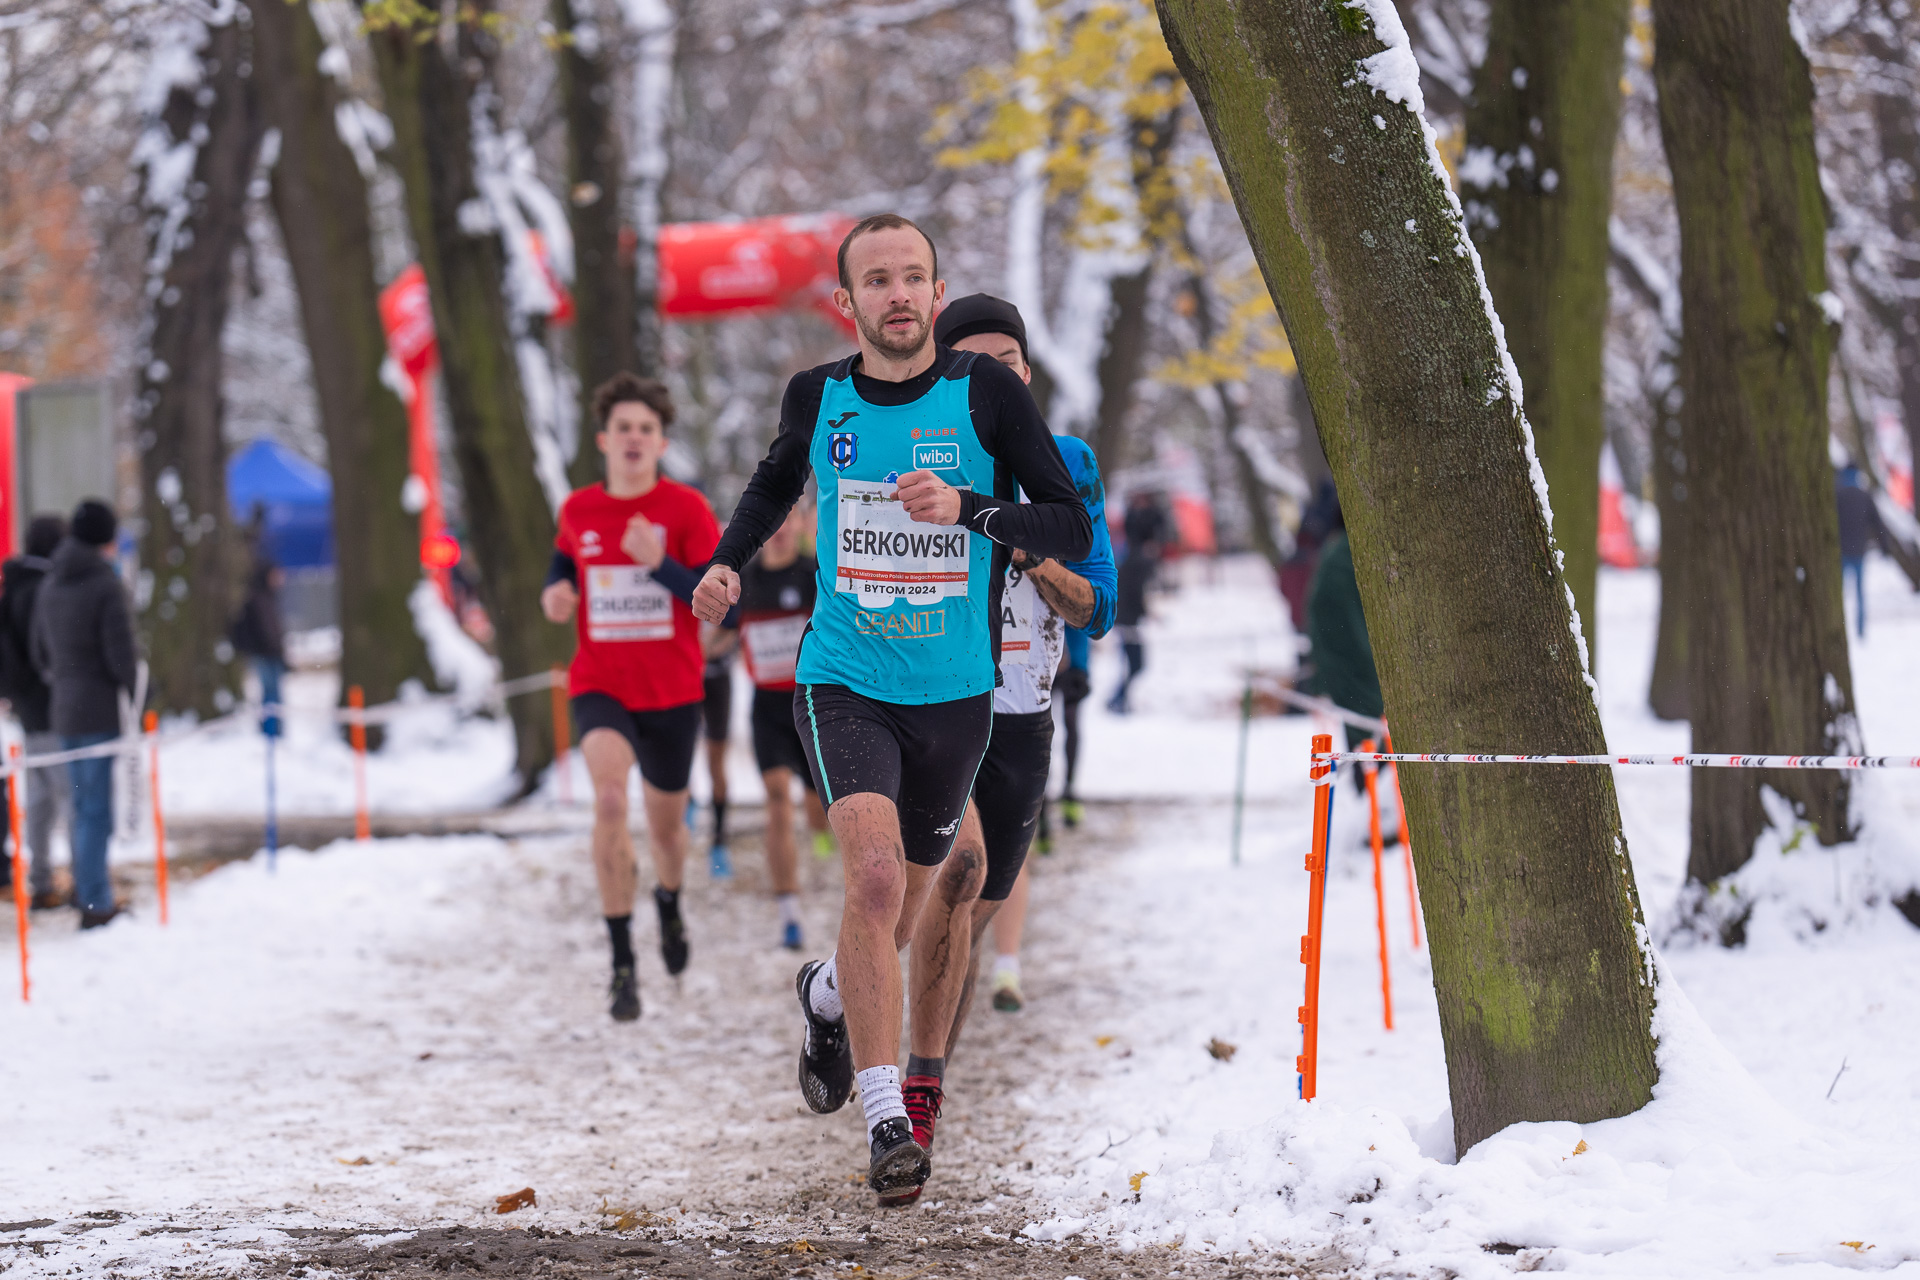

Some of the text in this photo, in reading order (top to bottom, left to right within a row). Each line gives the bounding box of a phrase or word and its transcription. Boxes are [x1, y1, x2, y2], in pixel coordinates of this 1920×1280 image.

[925, 428, 958, 437] CUBE
[831, 437, 852, 464] C
[919, 449, 953, 464] wibo
[842, 528, 965, 558] SERKOWSKI
[864, 584, 937, 595] BYTOM 2024
